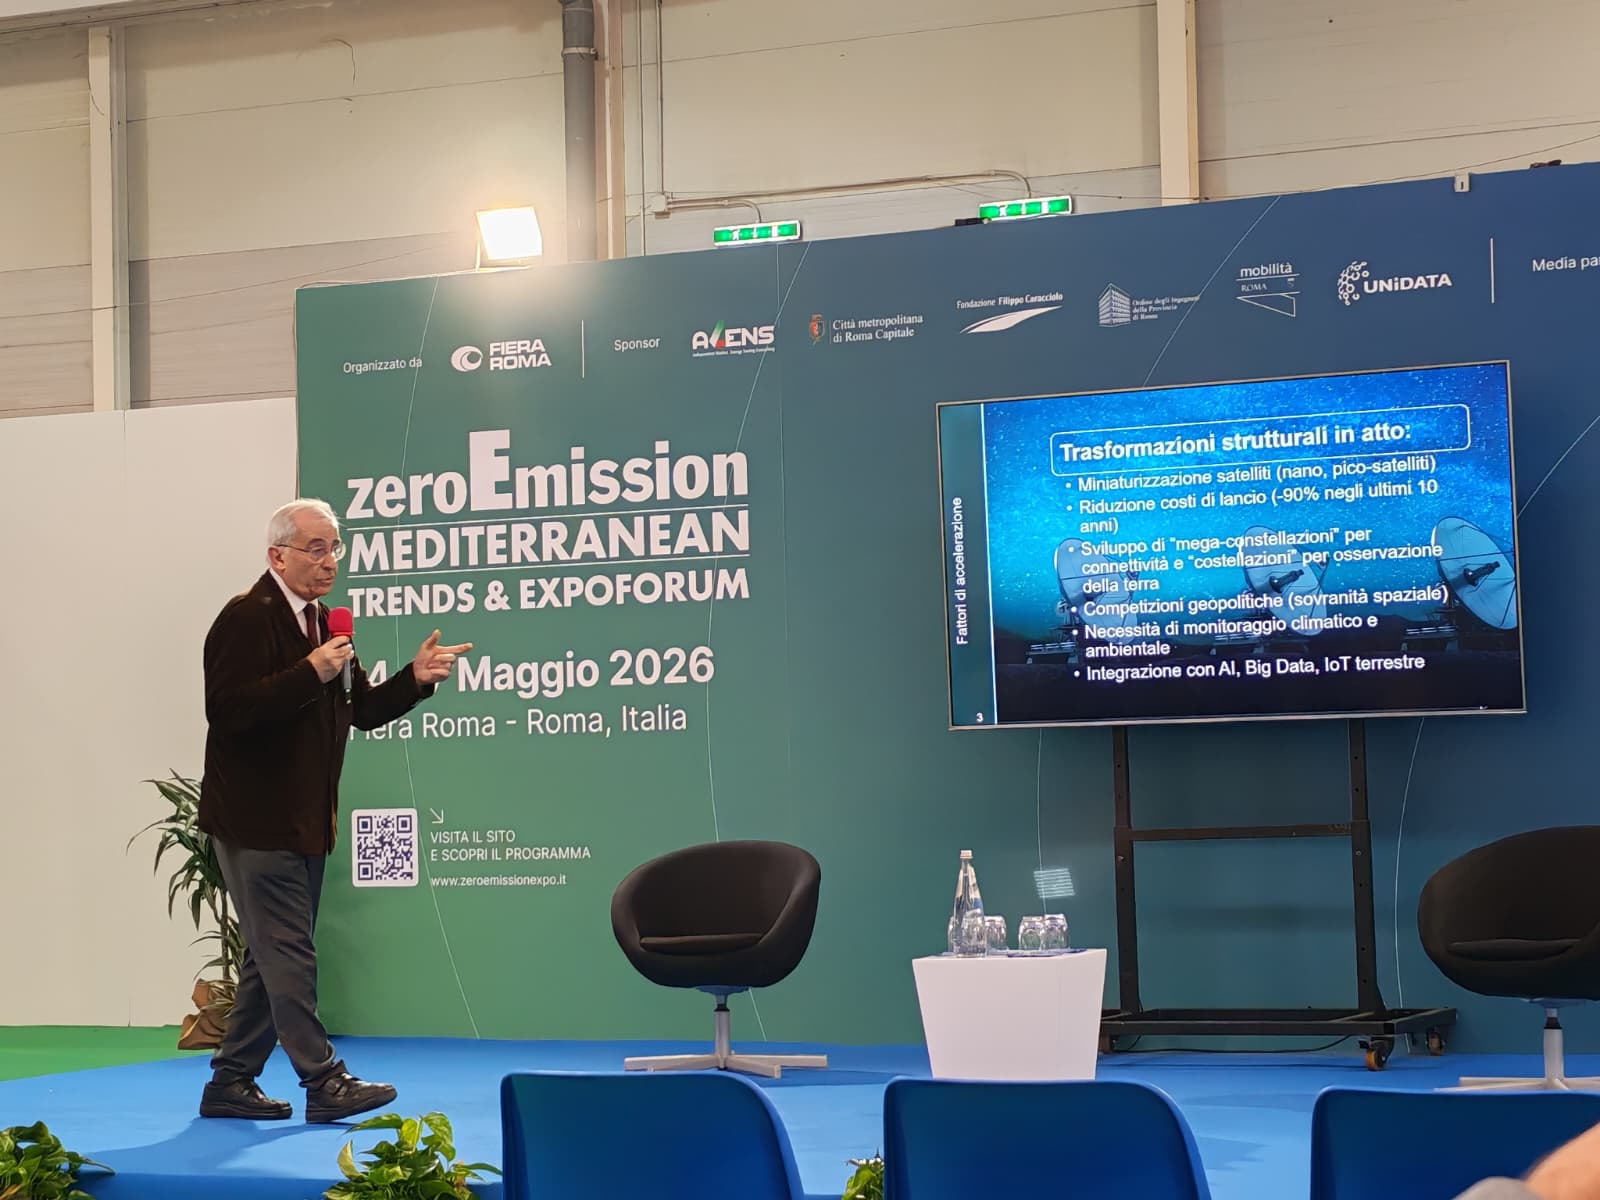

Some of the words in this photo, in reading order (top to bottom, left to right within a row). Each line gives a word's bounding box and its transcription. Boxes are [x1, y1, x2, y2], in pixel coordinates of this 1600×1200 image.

[1240, 262, 1293, 278] mobilità
[1532, 256, 1577, 272] Media
[1241, 283, 1268, 293] ROMA
[1363, 273, 1452, 293] UNiDATA
[956, 299, 996, 309] Fondazione
[998, 296, 1024, 306] Filippo
[1025, 292, 1064, 303] Caracciolo
[832, 317, 856, 331] Città
[858, 314, 923, 330] metropolitana
[614, 336, 661, 351] Sponsor
[833, 331, 843, 343] di
[845, 330, 873, 342] Roma
[875, 327, 915, 340] Capitale
[489, 339, 545, 356] FIERA
[343, 361, 406, 375] Organizzato
[408, 357, 423, 368] da
[489, 354, 552, 371] ROMA
[1059, 434, 1216, 462] Trasformazioni
[1222, 426, 1328, 451] strutturali
[1334, 423, 1355, 444] in
[1361, 423, 1411, 442] atto:
[346, 428, 749, 520] zeroEmission
[1078, 472, 1212, 492] Miniaturizzazione
[1216, 467, 1272, 482] satelliti
[1276, 463, 1328, 484] (nano,
[1332, 455, 1436, 478] pico-satelliti)
[1079, 499, 1156, 514] Riduzione
[1160, 496, 1197, 509] costi
[1200, 494, 1215, 507] di
[1219, 492, 1267, 506] lancio
[1271, 486, 1319, 506] (-90%
[1324, 486, 1363, 504] negli
[1368, 483, 1412, 497] ultimi
[1417, 480, 1438, 494] 10
[1080, 518, 1119, 534] anni)
[348, 508, 750, 573] MEDITERRANEAN
[952, 496, 966, 585] accelerazione
[1080, 542, 1148, 558] Sviluppo
[1151, 538, 1166, 552] di
[1344, 530, 1372, 546] per
[1081, 559, 1168, 575] connettività
[1173, 560, 1184, 570] e
[1302, 552, 1329, 568] per
[1333, 545, 1442, 562] osservazione
[347, 581, 475, 618] TRENDS
[484, 580, 512, 611] &
[519, 567, 751, 610] EXPOFORUM
[1082, 579, 1118, 593] della
[1123, 578, 1159, 591] terra
[954, 588, 966, 601] di
[1083, 600, 1184, 618] Competizioni
[1188, 594, 1283, 614] geopolitiche
[1288, 590, 1368, 608] (sovranità
[1372, 585, 1449, 605] spaziale)
[956, 603, 969, 645] Fattori
[1084, 623, 1160, 639] Necessità
[1165, 622, 1179, 636] di
[1183, 617, 1286, 634] monitoraggio
[1291, 613, 1362, 629] climatico
[1367, 617, 1378, 627] e
[1085, 642, 1170, 657] ambientale
[457, 650, 600, 700] Maggio
[608, 645, 715, 686] 2026
[1086, 666, 1182, 683] Integrazione
[1186, 663, 1214, 678] con
[1218, 661, 1241, 678] AI,
[1245, 659, 1271, 677] Big
[1276, 657, 1319, 674] Data,
[1324, 656, 1351, 671] IoT
[1356, 654, 1426, 670] terrestre
[422, 711, 497, 739] Roma
[526, 707, 612, 738] Roma,
[621, 703, 687, 733] Italia
[976, 712, 983, 723] 3
[430, 831, 469, 843] VISITA
[472, 831, 482, 843] IL
[487, 830, 516, 843] SITO
[431, 849, 438, 861] E
[442, 849, 488, 861] SCOPRI
[492, 848, 501, 860] IL
[505, 846, 591, 860] PROGRAMMA
[431, 874, 567, 887] www.zeroemissionexpo.it
